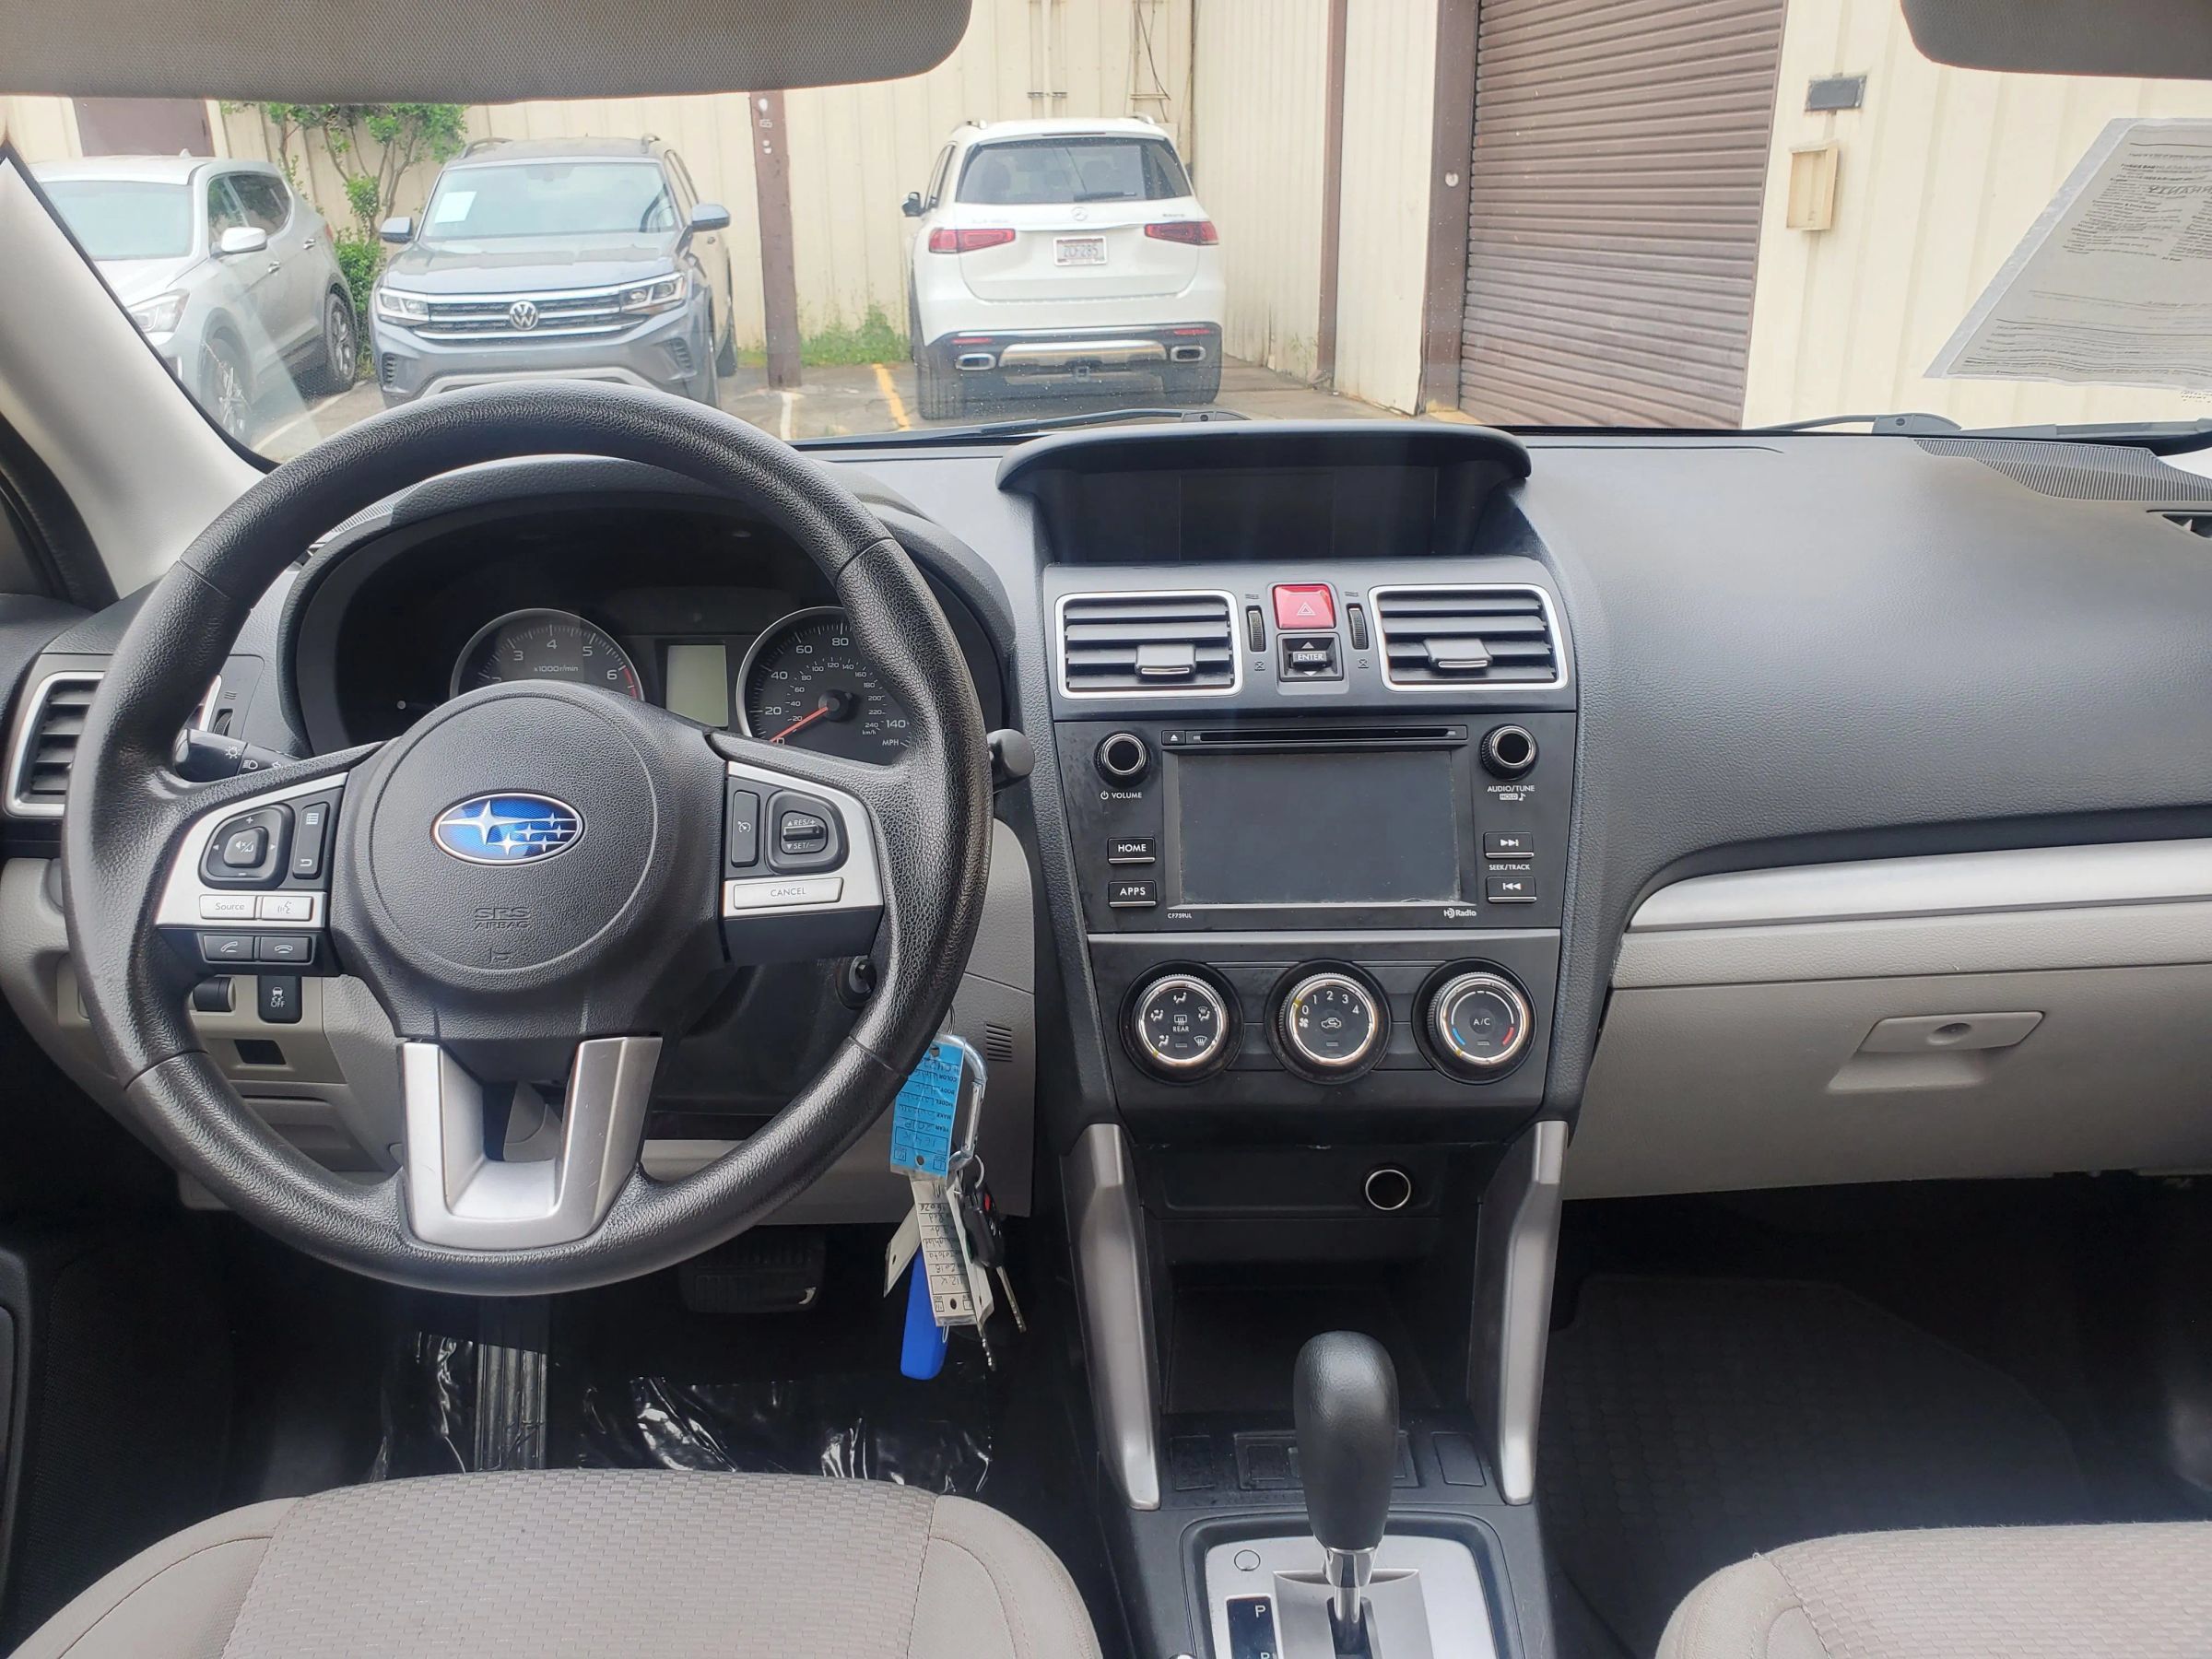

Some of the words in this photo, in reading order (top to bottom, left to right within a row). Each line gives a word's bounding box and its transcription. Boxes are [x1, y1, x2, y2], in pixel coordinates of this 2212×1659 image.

[547, 640, 558, 650] 4
[831, 637, 849, 646] 80
[582, 645, 593, 657] 5
[795, 645, 813, 654] 60
[513, 650, 524, 661] 3
[606, 669, 618, 680] 6
[771, 671, 788, 680] 40
[765, 706, 782, 715] 20
[886, 719, 906, 728] 140
[882, 738, 900, 747] MPH
[1487, 784, 1535, 793] AUDIO/TUNE
[1117, 844, 1147, 853] HOME
[771, 887, 806, 898] CANCEL
[1119, 887, 1146, 896] APPS
[215, 902, 245, 911] Source
[1312, 994, 1317, 1005] 1
[1326, 991, 1334, 1001] 2
[1342, 994, 1349, 1005] 3
[270, 999, 286, 1008] OFF
[1301, 1005, 1310, 1015] 0
[1352, 1005, 1359, 1015] 4
[1473, 1018, 1491, 1026] A/C
[1254, 1605, 1266, 1618] P
